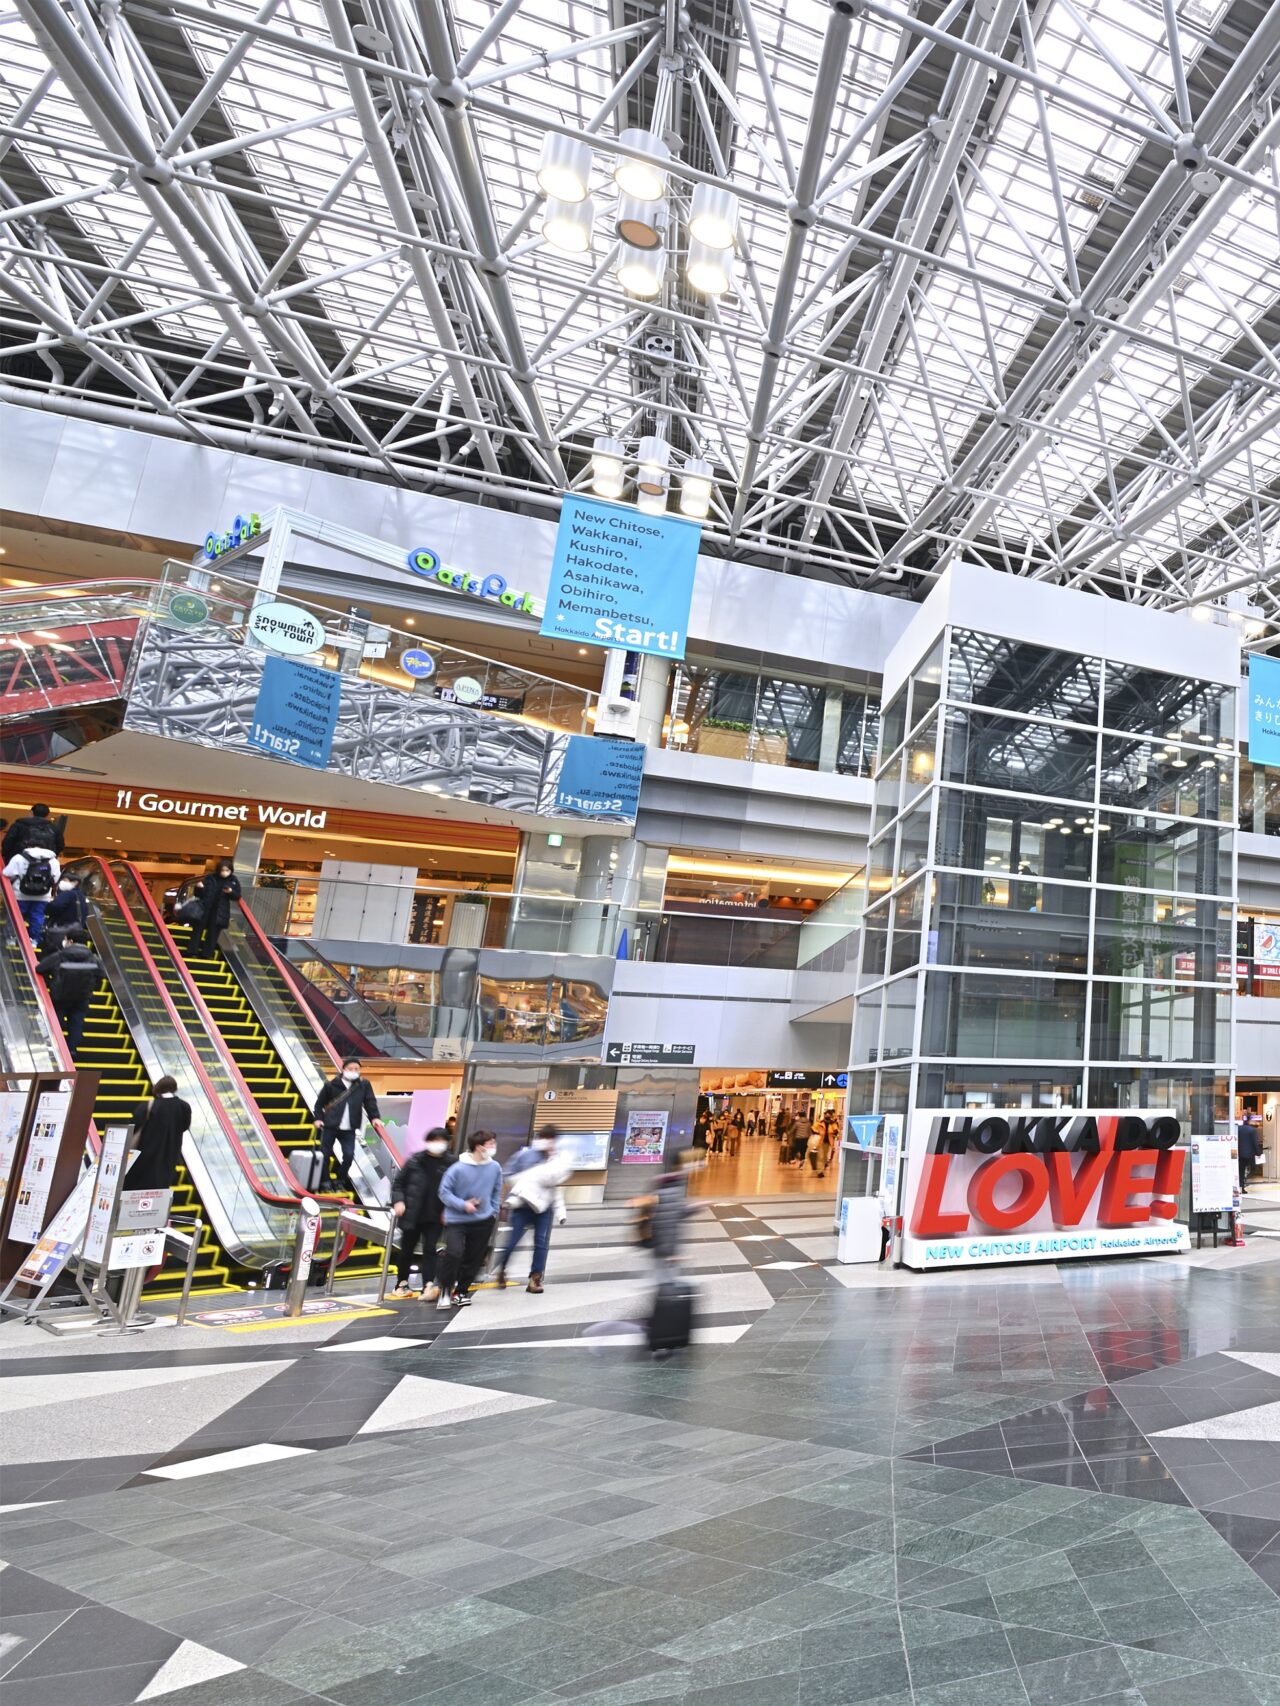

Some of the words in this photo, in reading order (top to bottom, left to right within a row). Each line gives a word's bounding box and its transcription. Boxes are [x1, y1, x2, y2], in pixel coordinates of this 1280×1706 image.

[572, 524, 642, 549] Wakkanai,
[574, 509, 606, 524] New
[609, 517, 665, 539] Chitose,
[569, 539, 628, 561] Kushiro,
[566, 554, 638, 578] Hakodate,
[560, 584, 618, 605] Obihiro,
[563, 569, 644, 595] Asahikawa,
[558, 599, 654, 627] Memanbetsu,
[254, 622, 276, 634] SKY
[555, 625, 589, 637] Hokkaido
[595, 617, 678, 651] Start!
[138, 793, 249, 821] Gourmet
[258, 805, 327, 829] World
[926, 1115, 1181, 1154] HOKKAIDO
[909, 1149, 1186, 1235] LOVE!
[925, 1245, 963, 1261] NEW
[968, 1241, 1032, 1258] CHITOSE
[1034, 1237, 1097, 1254] AIRPORT
